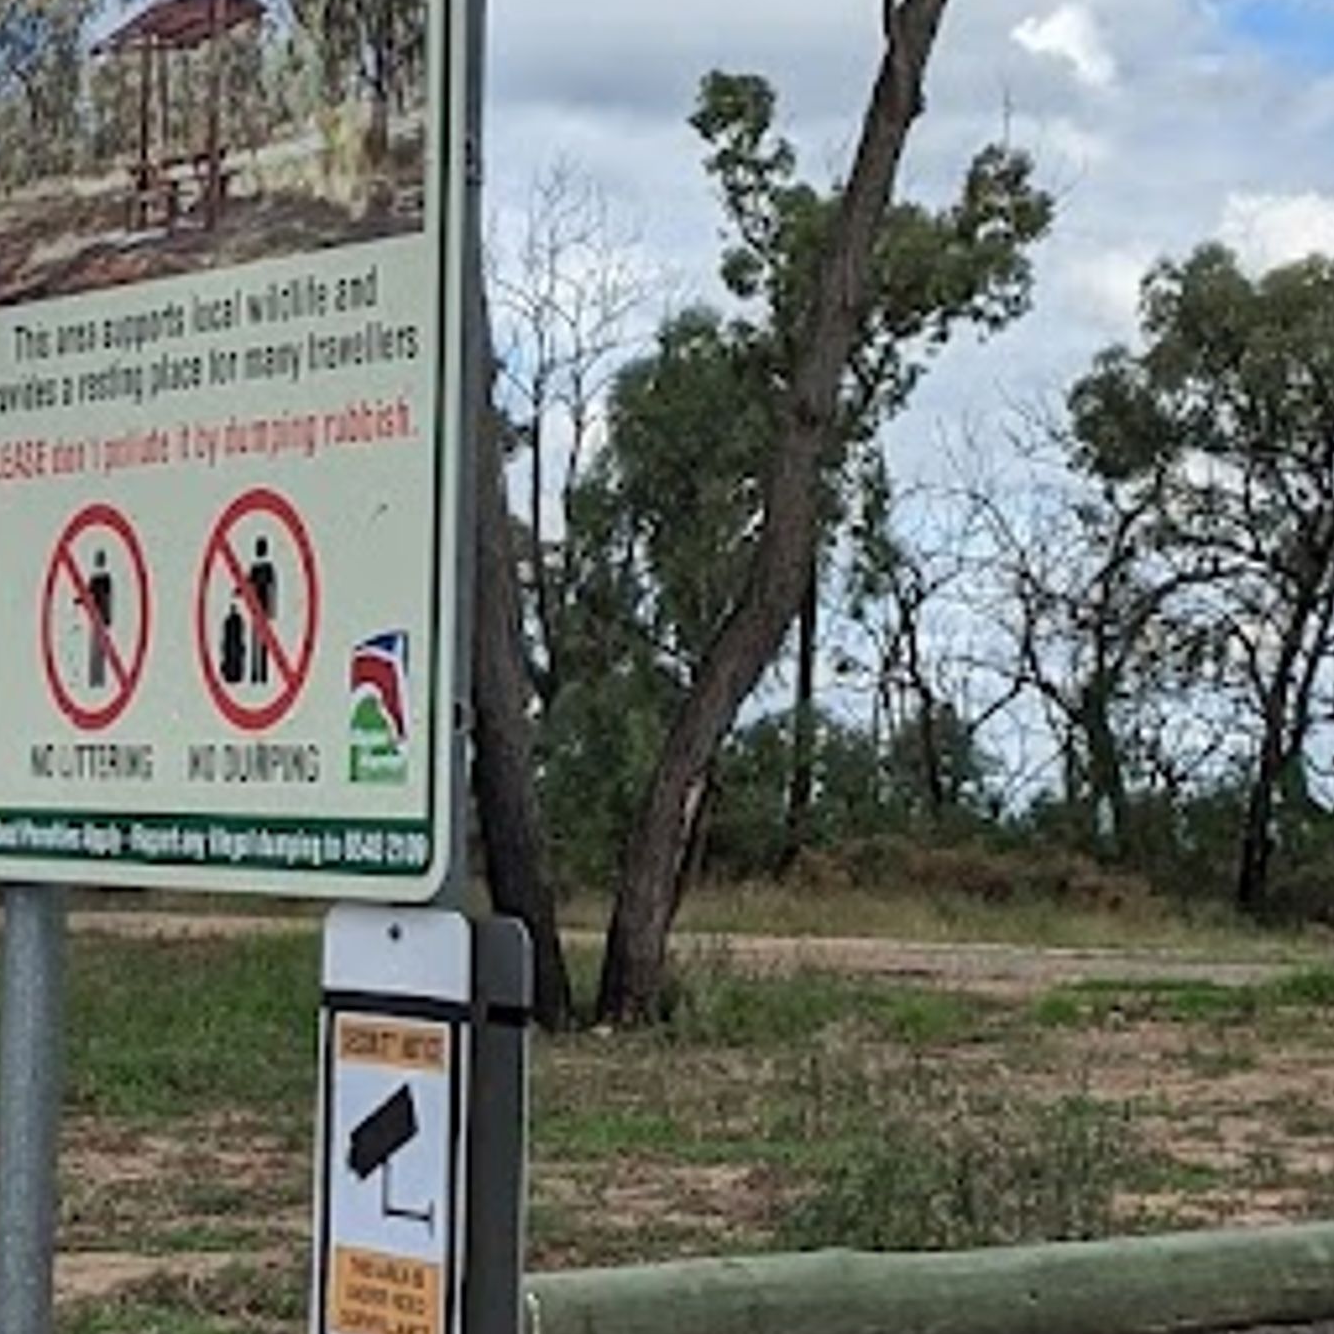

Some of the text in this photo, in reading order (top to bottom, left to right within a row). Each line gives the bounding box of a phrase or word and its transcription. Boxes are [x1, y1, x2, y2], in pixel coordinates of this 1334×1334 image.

[14, 264, 377, 361] This area supports local wildlife and
[62, 376, 73, 406] a
[78, 359, 143, 405] resting
[150, 352, 201, 396] place
[208, 348, 238, 386] for
[245, 342, 302, 383] many
[308, 322, 419, 371] travellers
[195, 422, 216, 468] by
[224, 410, 316, 460] dumping
[31, 743, 154, 781] NO LITTERING
[188, 743, 217, 783] NO
[223, 743, 321, 784] DUMPING
